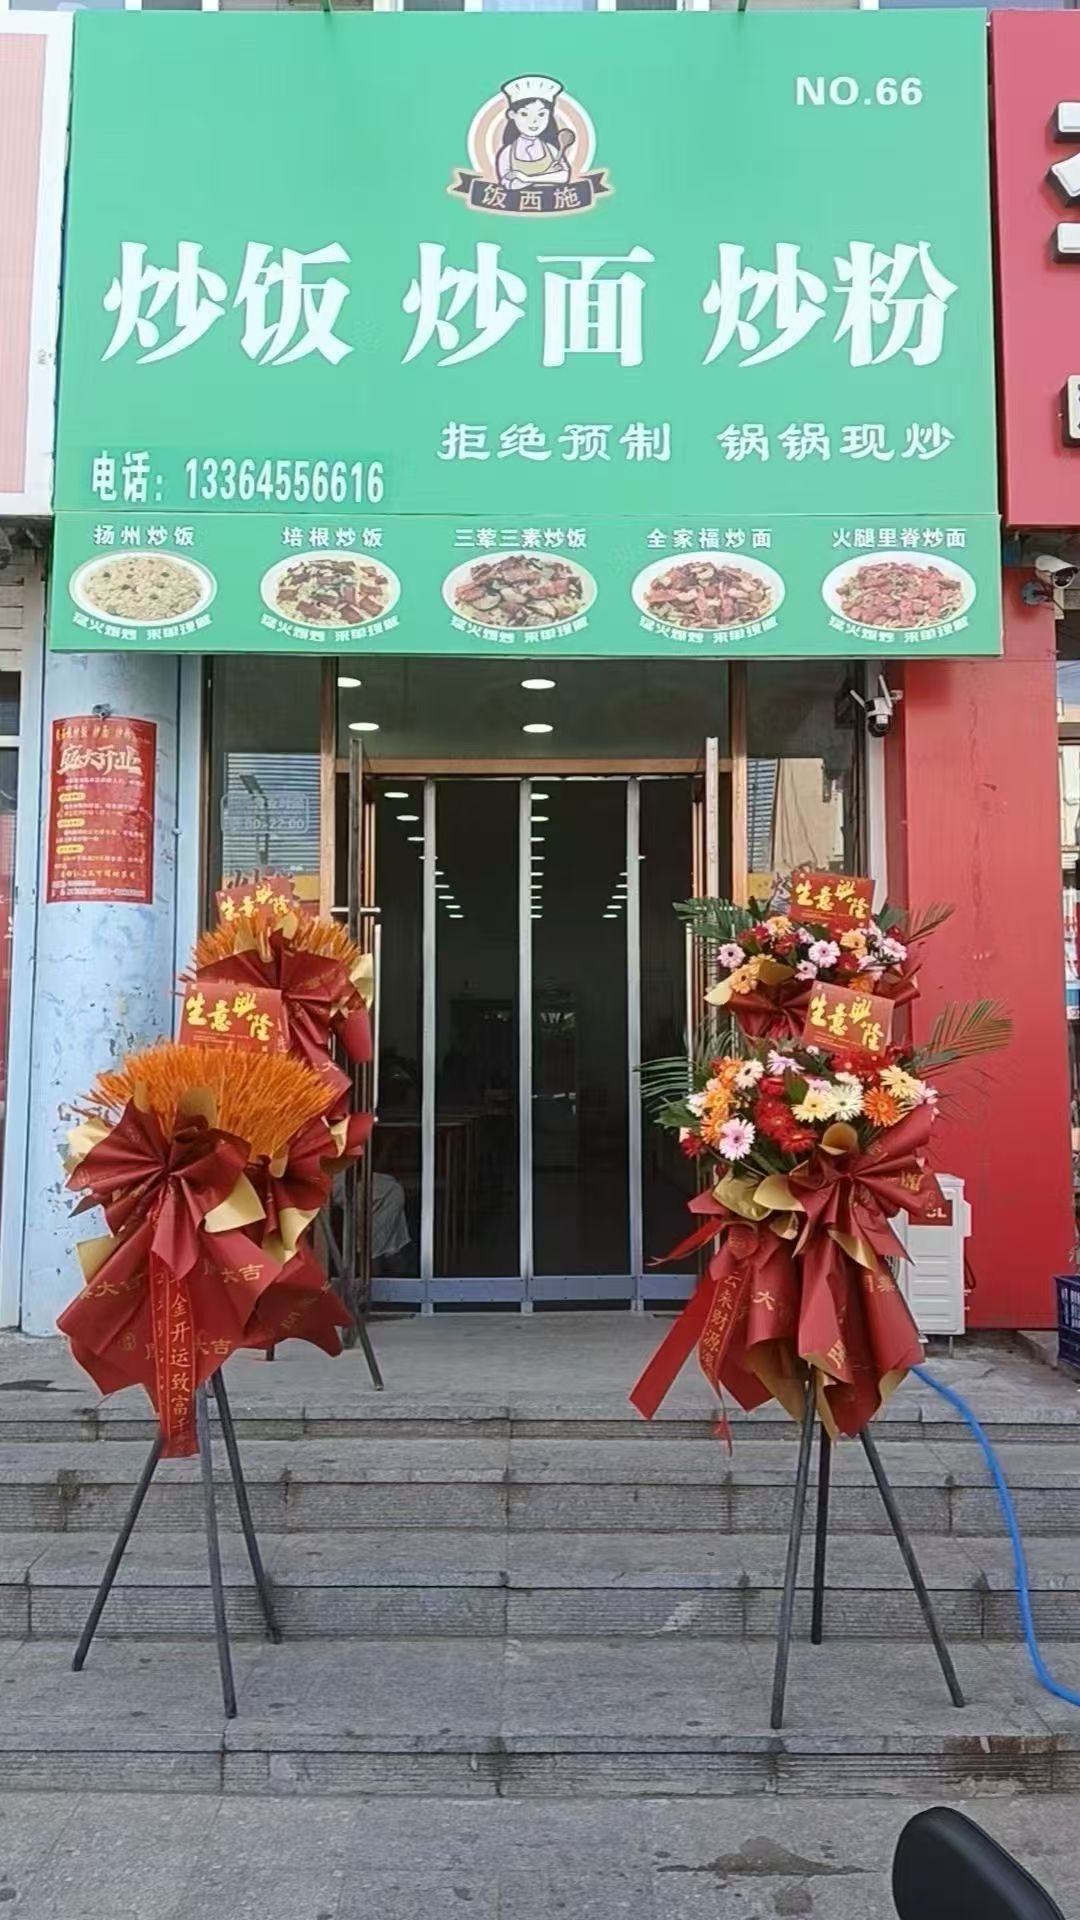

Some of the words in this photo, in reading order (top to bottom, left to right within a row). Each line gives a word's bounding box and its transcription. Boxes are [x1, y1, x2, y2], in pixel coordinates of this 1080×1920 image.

[796, 77, 923, 107] NO.66
[482, 184, 581, 211] 饭西施
[100, 241, 354, 366] 炒饭
[402, 241, 656, 367] 炒面
[702, 241, 957, 367] 炒粉
[437, 422, 674, 462] 拒绝预制
[716, 422, 956, 462] 锅锅现炒
[185, 457, 385, 503] 13364556616
[93, 524, 196, 546] 扬州炒饭
[281, 526, 384, 548] 培根炒饭
[453, 527, 587, 549] 三荤三素炒饭
[646, 528, 773, 549] 全家福炒面
[831, 528, 967, 548] 火腿里脊炒面
[57, 744, 143, 775] 盛大开业
